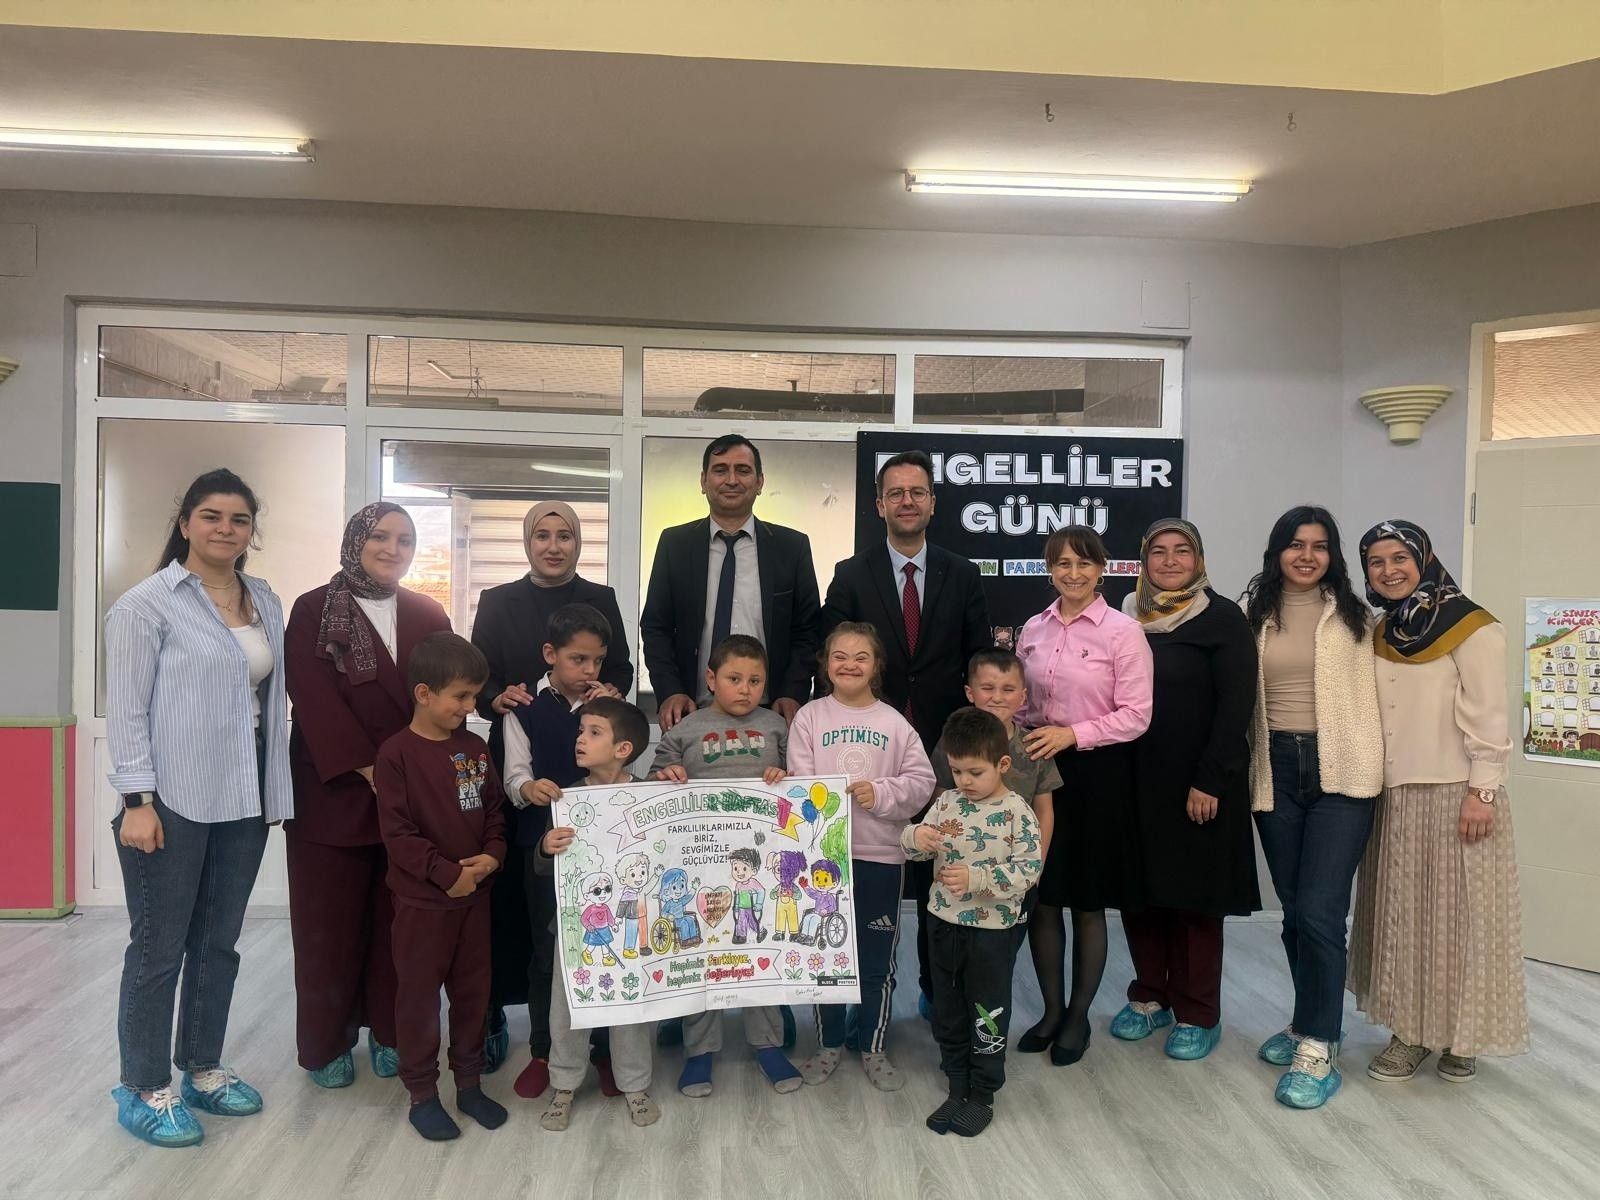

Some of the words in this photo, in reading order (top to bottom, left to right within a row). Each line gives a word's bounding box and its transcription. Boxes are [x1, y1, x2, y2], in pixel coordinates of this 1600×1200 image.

[874, 444, 1173, 488] GELLİLER
[960, 495, 1109, 536] GÜNÜ
[822, 728, 889, 751] OPTIMIST
[633, 791, 719, 829] ENGELLİLER
[667, 821, 752, 834] FARKLILIKLARIMIZLA
[681, 843, 730, 855] SEVGİMİZLE
[682, 855, 728, 866] GÜÇLÜYÜZ!
[669, 957, 705, 974] Hepimiz
